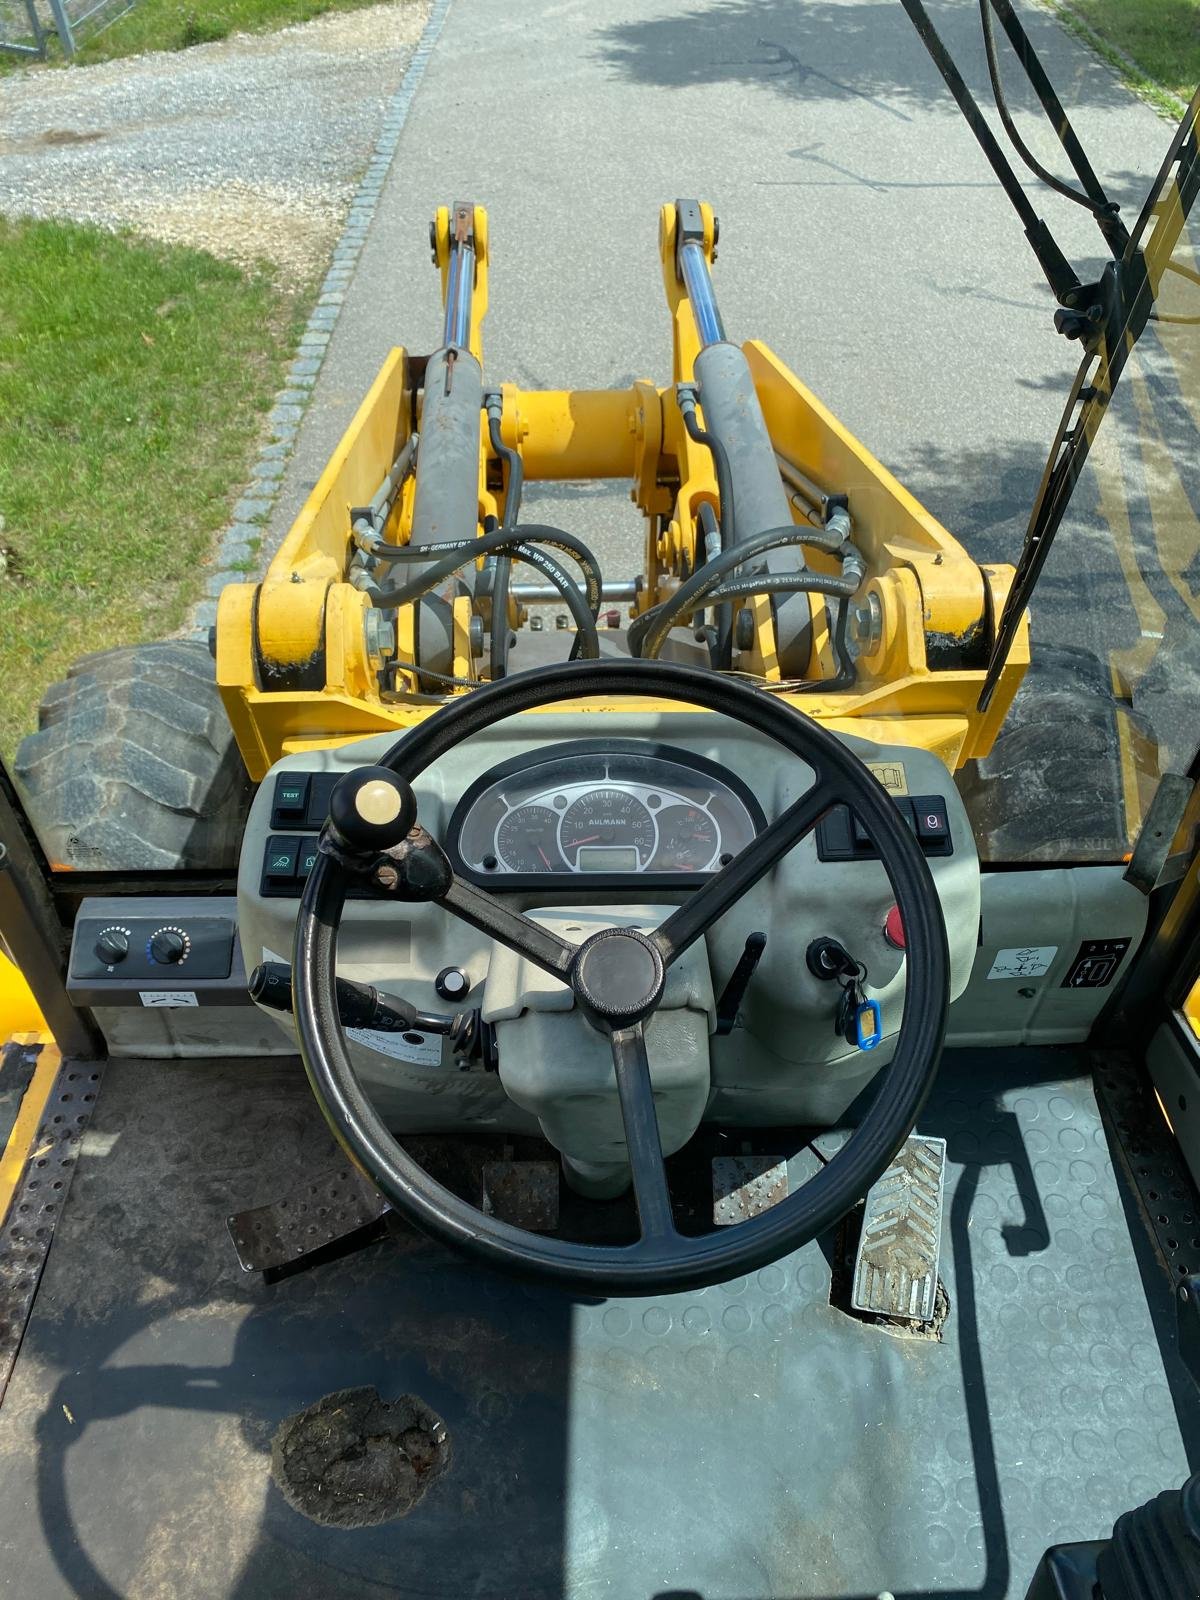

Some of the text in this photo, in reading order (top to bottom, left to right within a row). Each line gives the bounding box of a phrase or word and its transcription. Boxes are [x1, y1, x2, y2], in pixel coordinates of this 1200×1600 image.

[532, 552, 544, 563] WP
[543, 560, 556, 573] 250
[553, 570, 569, 589] BAR
[602, 800, 612, 808] 30
[583, 807, 593, 815] 20
[574, 821, 584, 829] 10
[631, 821, 642, 829] 50
[634, 837, 645, 845] 60
